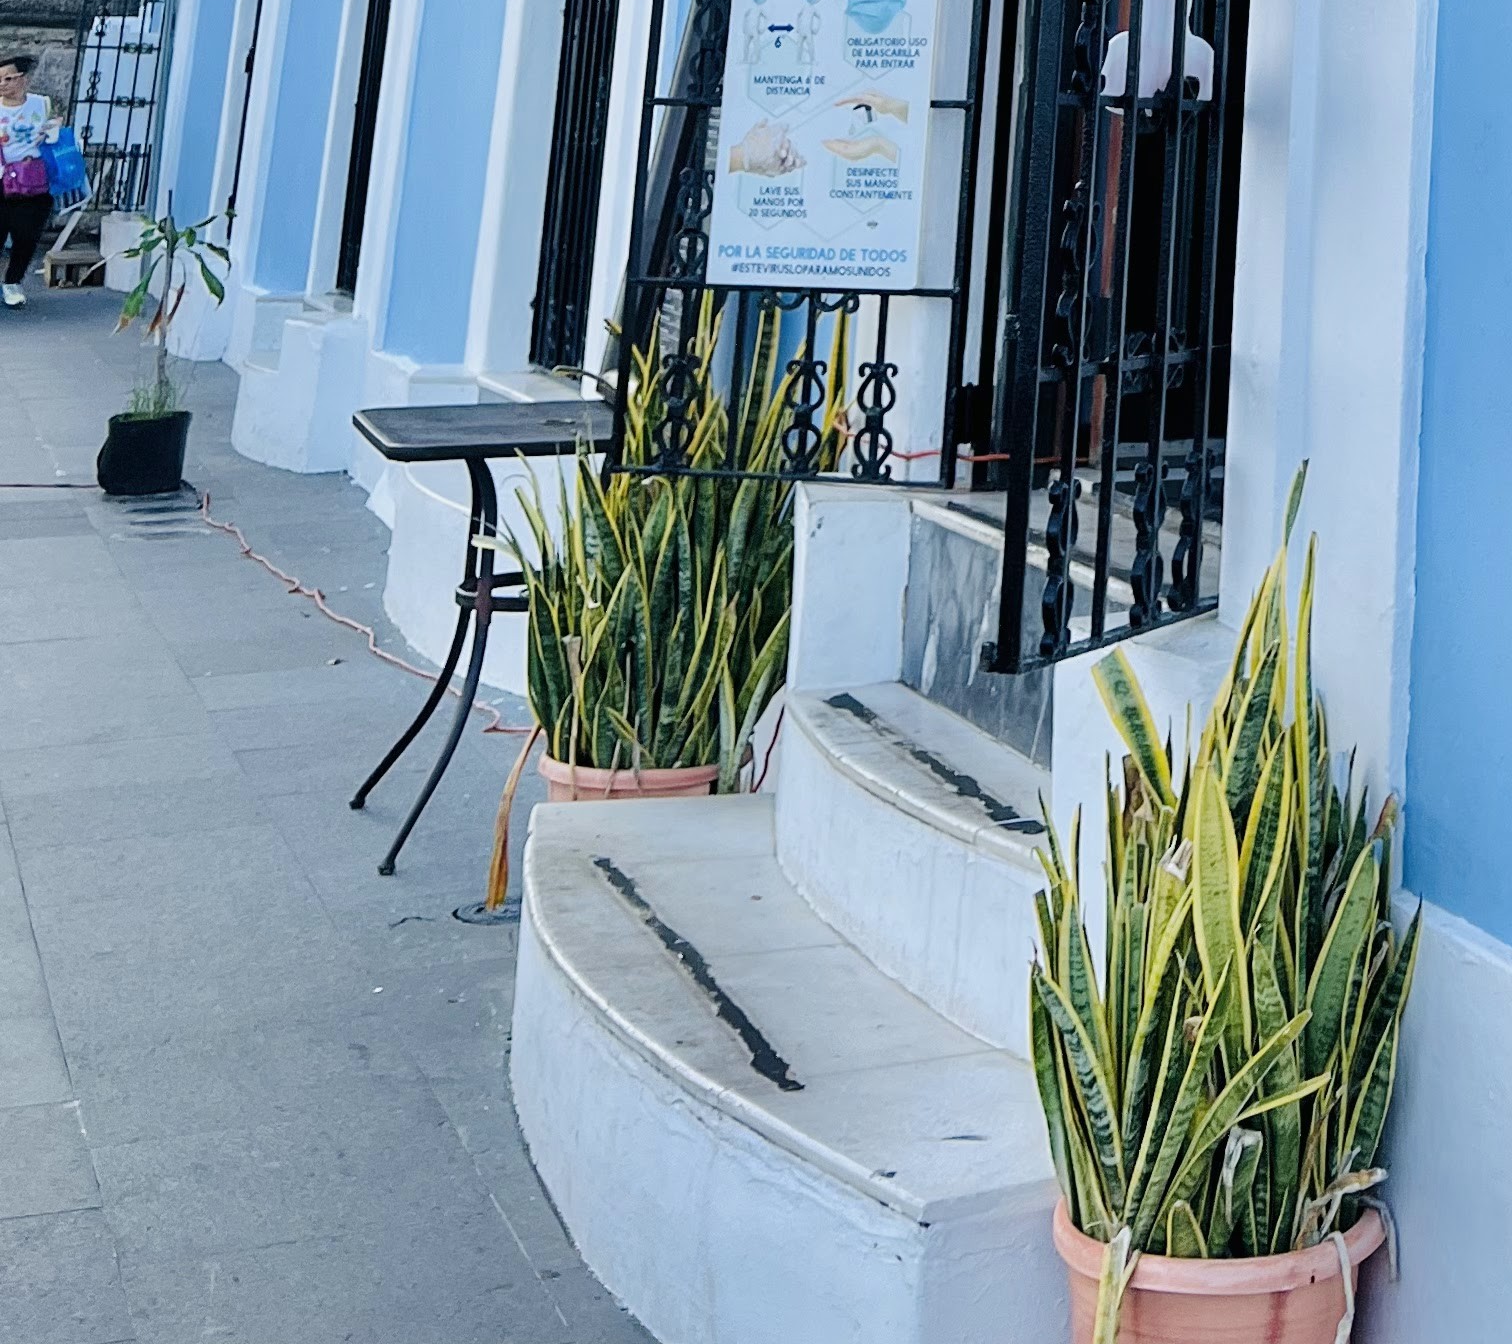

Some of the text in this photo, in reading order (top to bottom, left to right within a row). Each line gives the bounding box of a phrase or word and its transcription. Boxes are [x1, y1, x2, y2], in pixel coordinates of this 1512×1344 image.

[847, 37, 928, 47] OBLIGATORIO USO
[851, 48, 921, 58] DE MASCARILLA
[855, 59, 914, 68] PARA ENTRAR
[754, 75, 803, 85] MANTENGA
[814, 75, 826, 85] DE
[765, 86, 811, 96] DISTANCIA
[846, 167, 900, 178] DESINFECTE
[845, 179, 898, 189] SUS MANOS
[759, 186, 800, 196] LAVE SUS
[829, 190, 913, 201] CONSTANTEMENTE
[752, 197, 805, 207] MANOS POR
[761, 208, 808, 219] SEGUNDOS
[718, 244, 908, 263] POR LA SEGURIDAD DE TODOS
